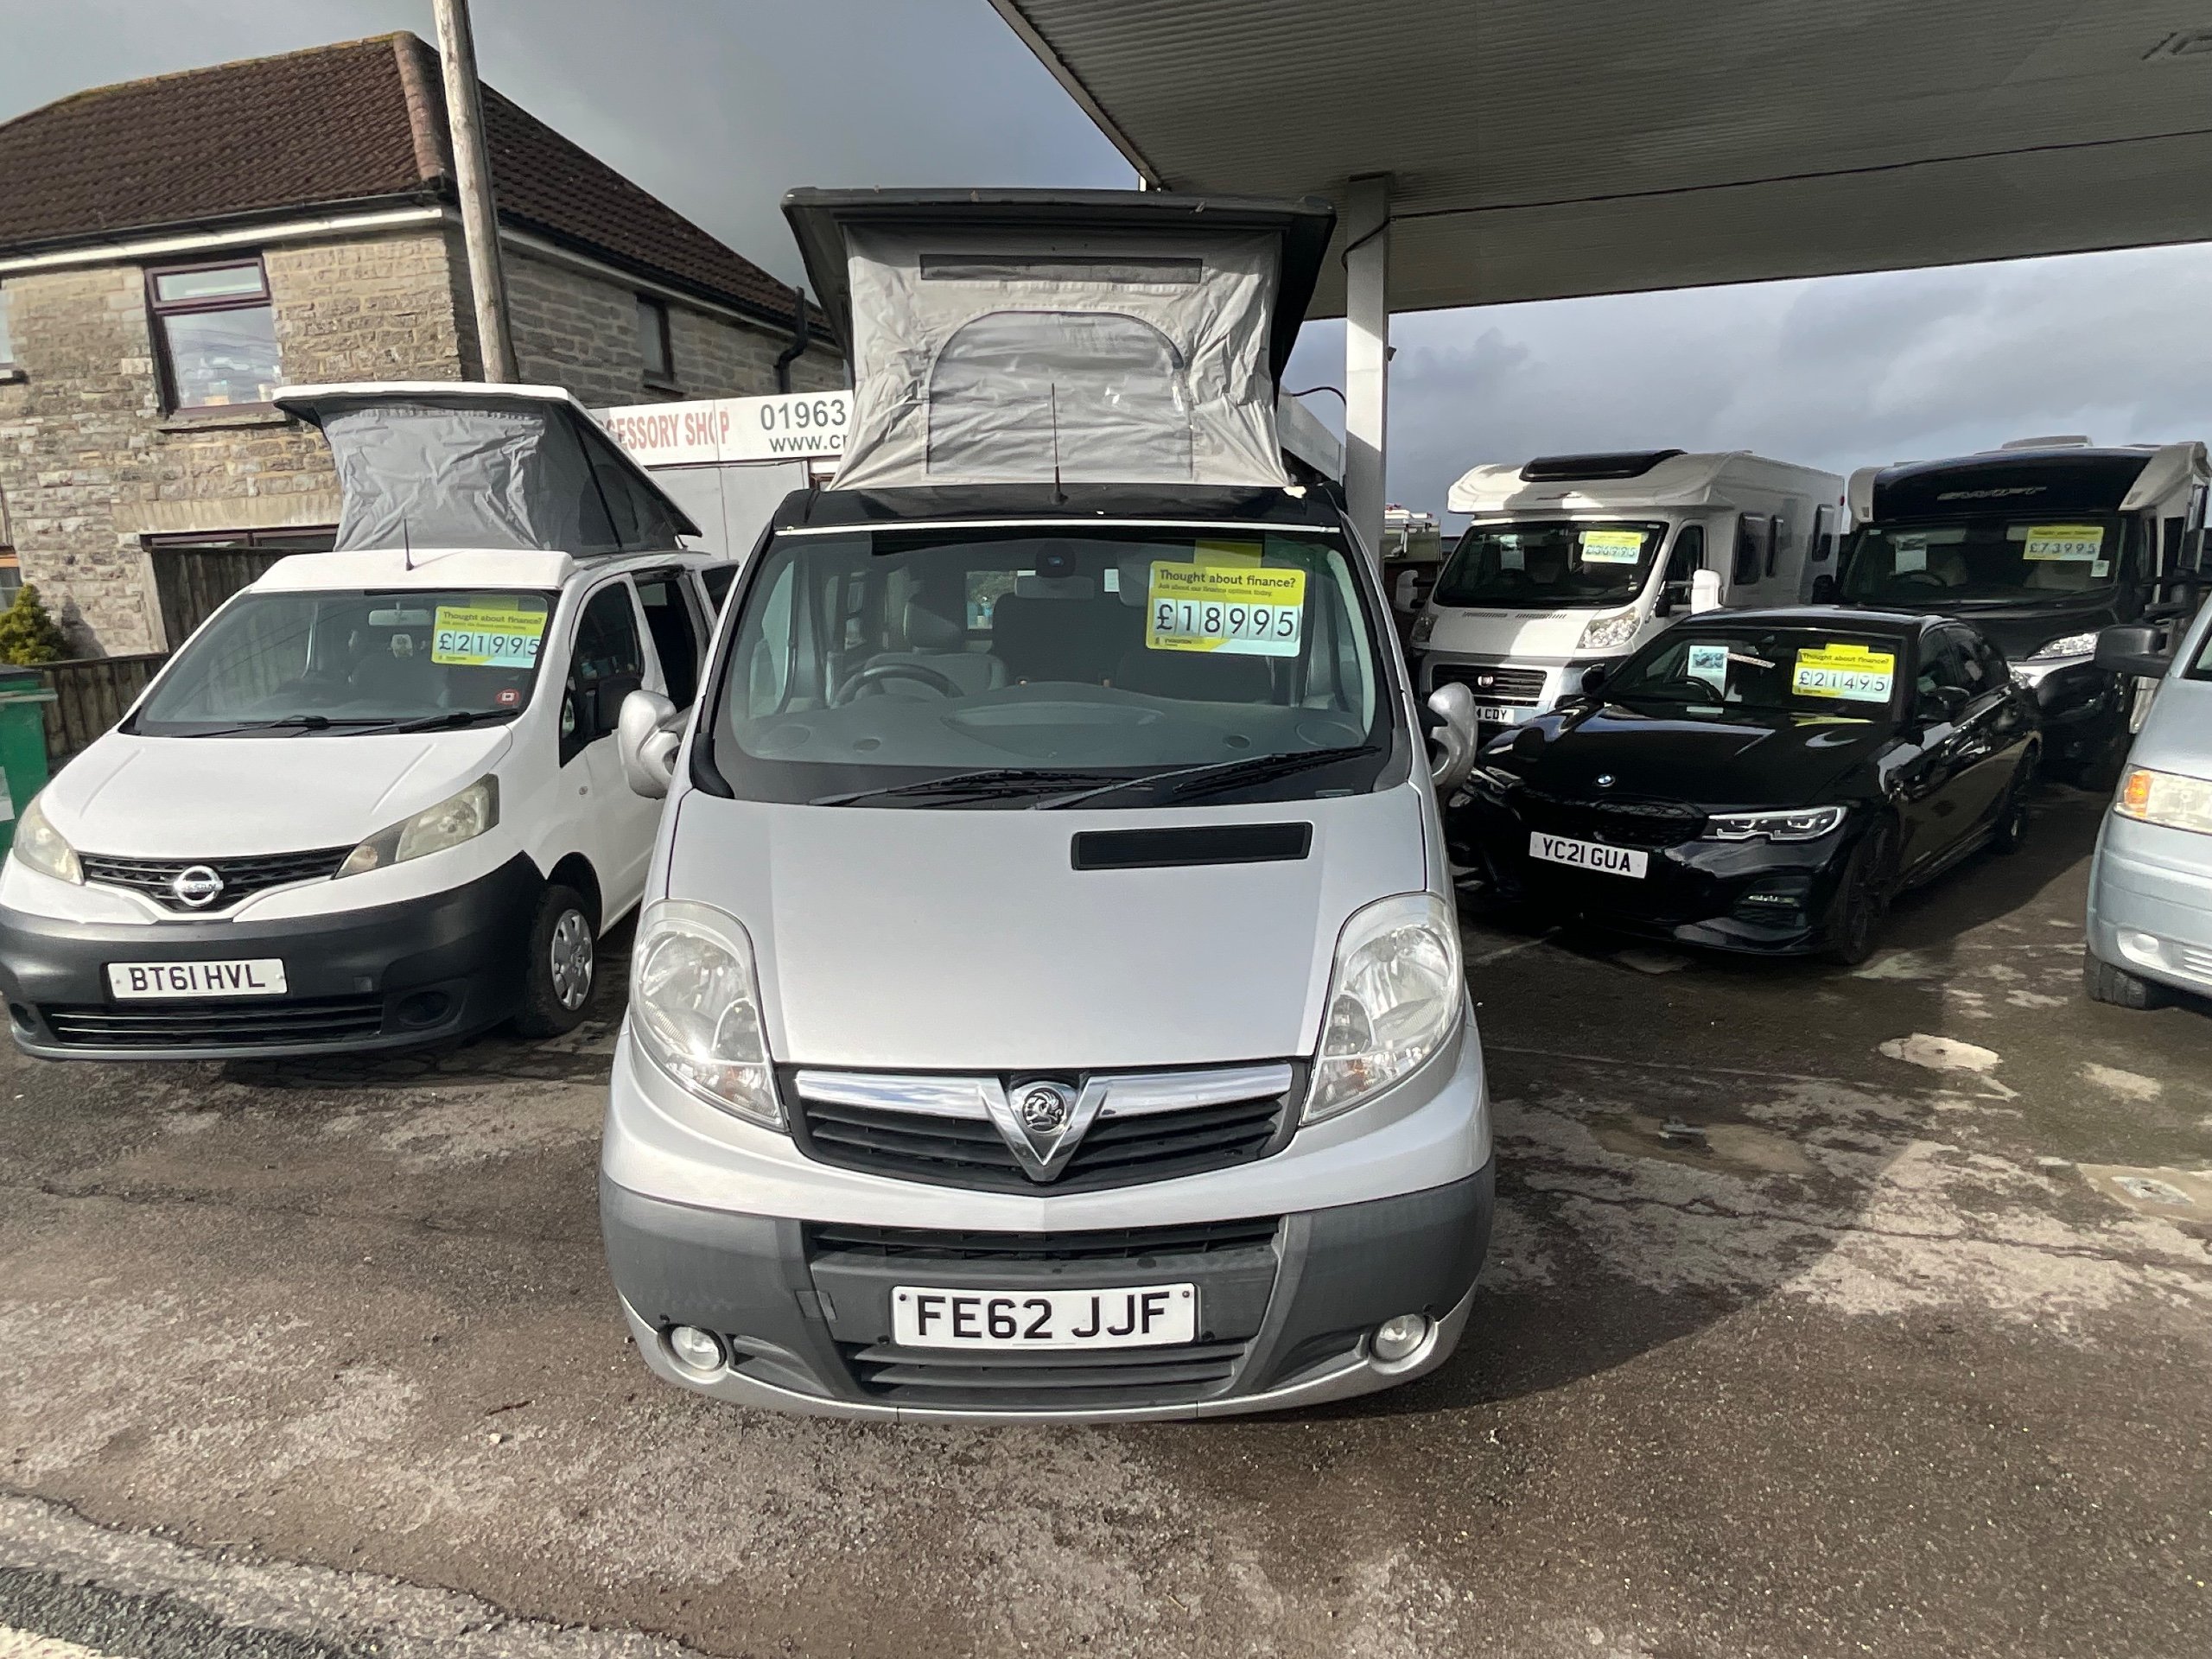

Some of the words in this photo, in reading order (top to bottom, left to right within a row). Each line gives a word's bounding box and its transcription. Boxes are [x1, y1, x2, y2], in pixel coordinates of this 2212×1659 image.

[760, 398, 847, 431] 01963
[597, 413, 679, 450] ESSORY
[1160, 569, 1205, 585] Thought
[1210, 575, 1243, 585] about
[1247, 575, 1296, 588] finance?
[443, 611, 478, 622] Thought
[508, 616, 543, 625] finance?
[1156, 603, 1294, 637] £18995
[438, 632, 540, 656] £21995
[1802, 652, 1833, 661] Thought
[1798, 671, 1886, 692] £21495
[1484, 709, 1508, 720] CDY
[1542, 837, 1586, 863] YC21
[1591, 848, 1631, 873] GUA
[128, 965, 198, 991] BT61
[204, 963, 266, 989] HVL
[917, 1294, 1053, 1339] FE62
[1071, 1291, 1171, 1338] JJF
